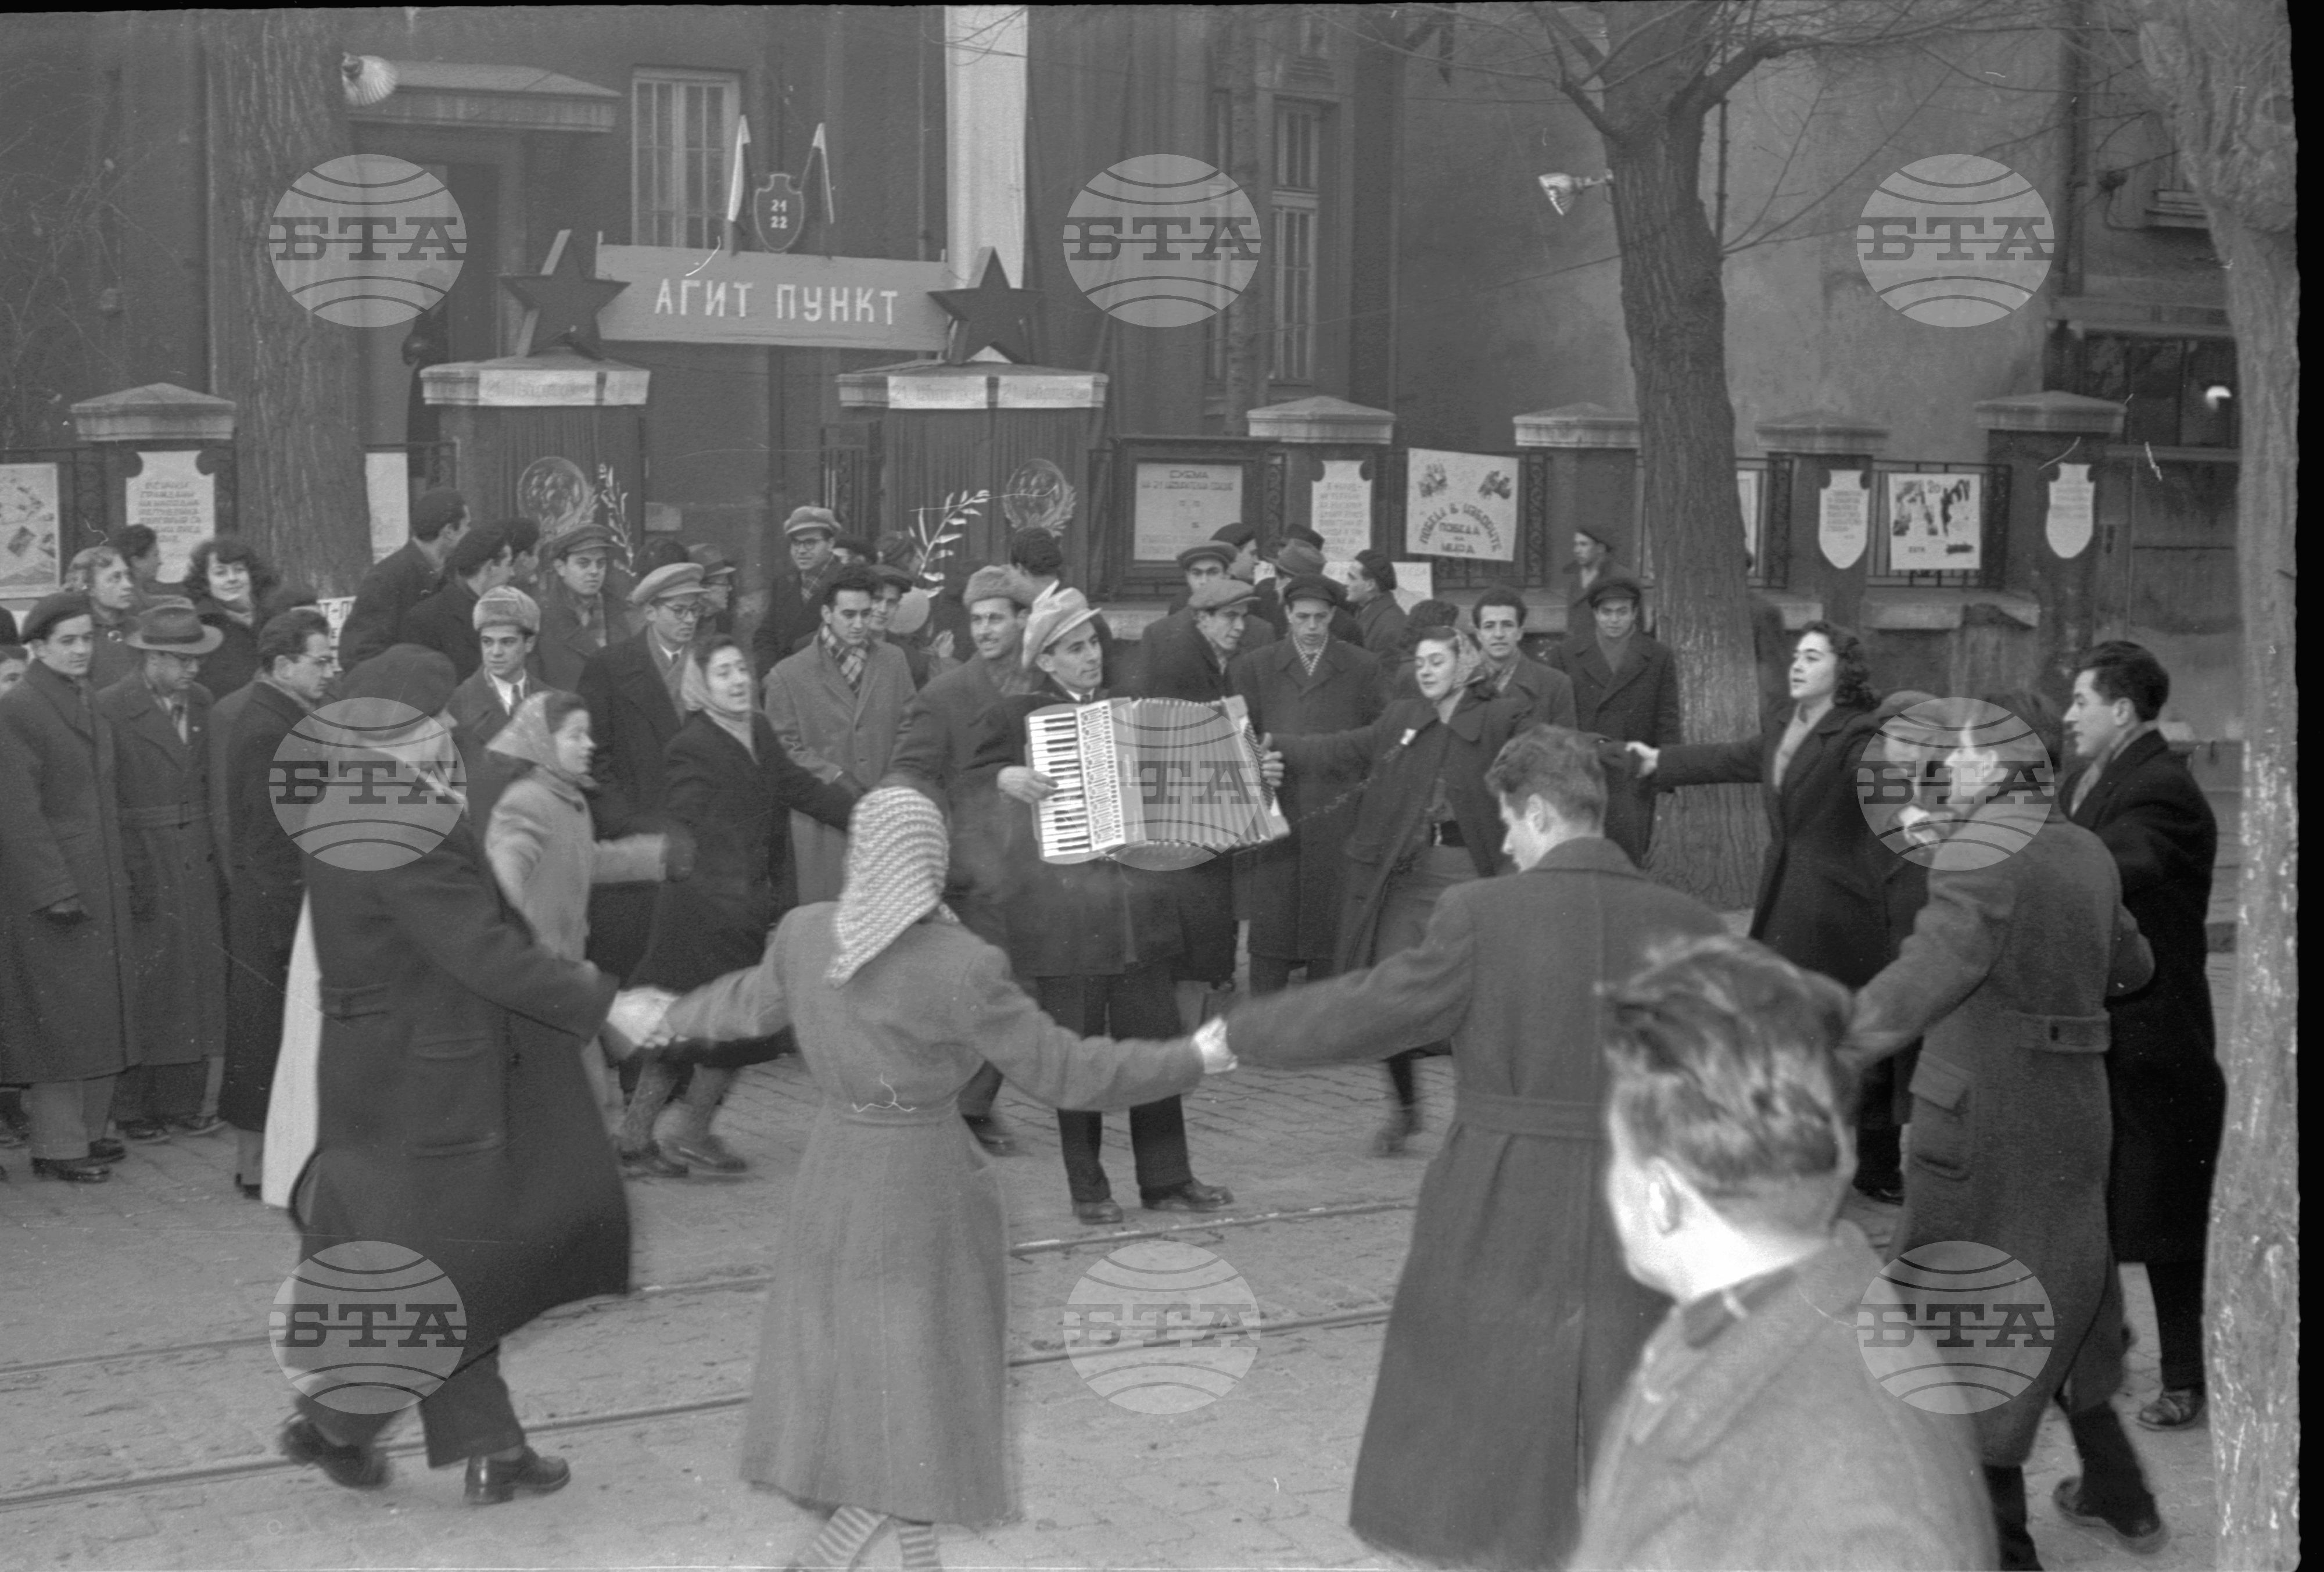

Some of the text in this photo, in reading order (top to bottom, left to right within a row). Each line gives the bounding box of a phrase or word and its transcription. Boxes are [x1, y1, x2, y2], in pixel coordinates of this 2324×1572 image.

[770, 199, 787, 212] 21
[770, 216, 788, 228] 22
[655, 278, 899, 324] АГИТ ПУНКТ
[1439, 522, 1480, 535] ПОБЕДА
[1441, 542, 1475, 554] МИРА
